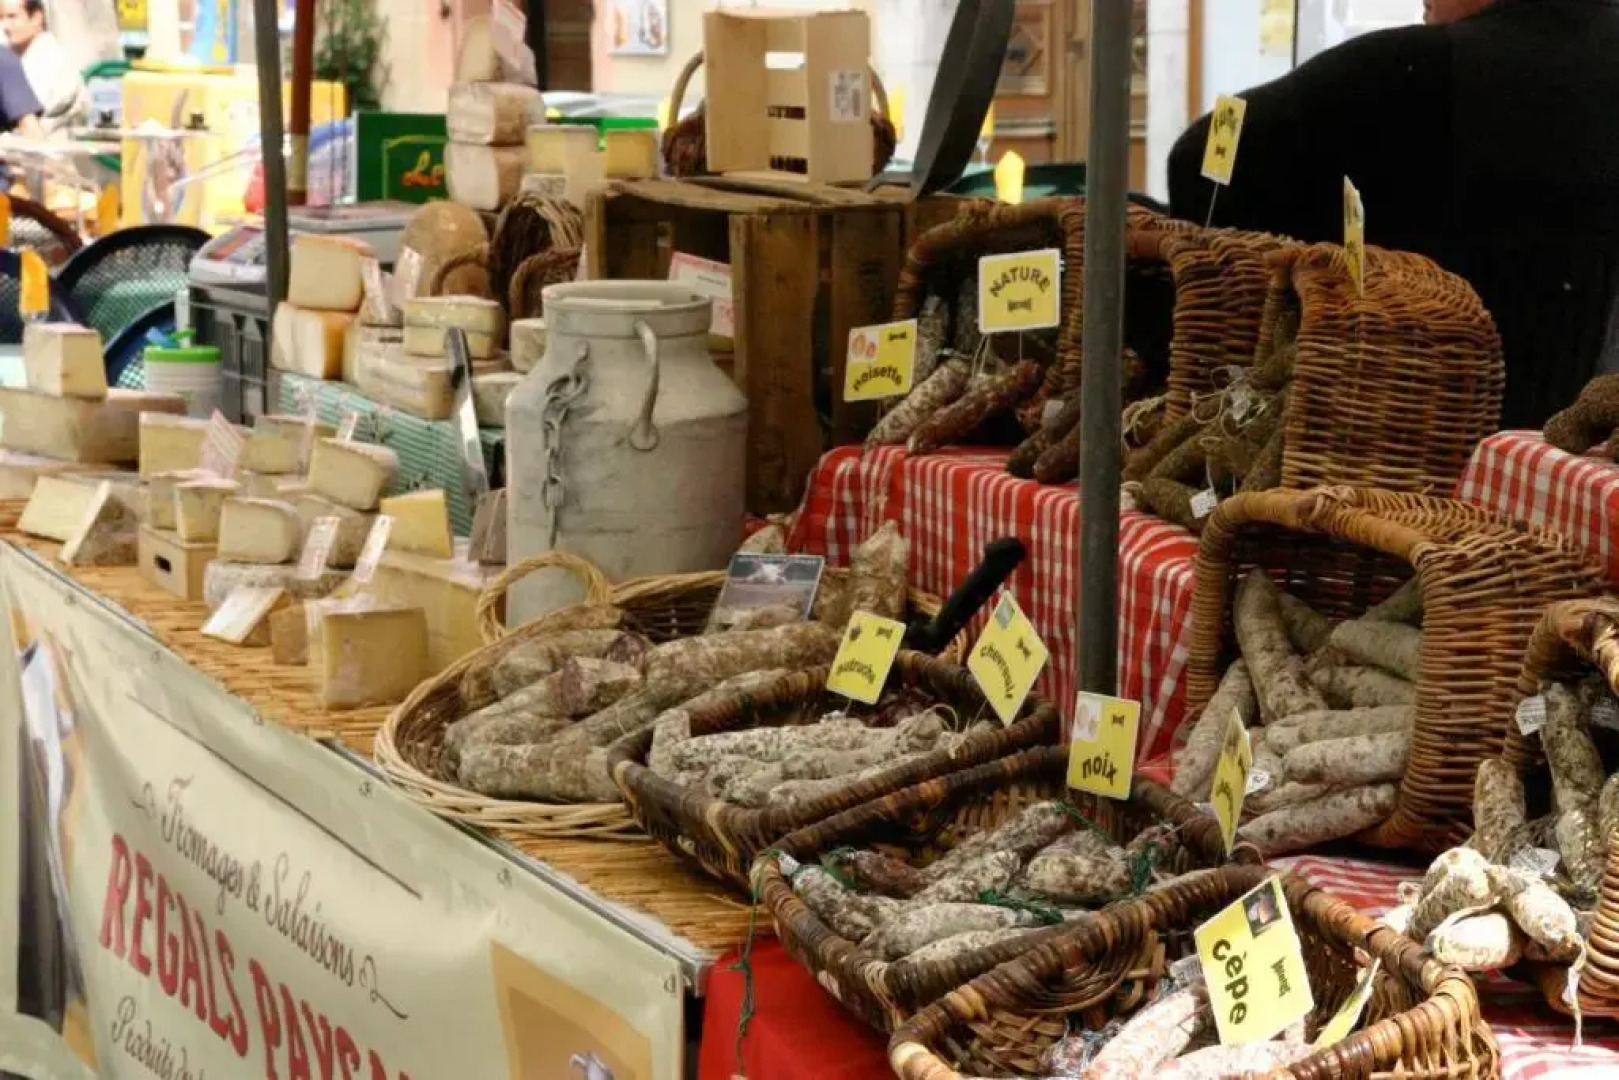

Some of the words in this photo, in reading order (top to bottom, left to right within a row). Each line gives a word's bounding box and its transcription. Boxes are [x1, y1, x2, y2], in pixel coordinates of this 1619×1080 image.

[989, 266, 1051, 297] NATURE
[853, 365, 902, 391] noisette
[1083, 752, 1117, 787] noix
[161, 774, 243, 916] Fromages
[246, 860, 262, 912] &
[263, 852, 354, 987] Salaisons
[99, 833, 249, 1058] REGALS
[1212, 938, 1250, 1025] cèpe
